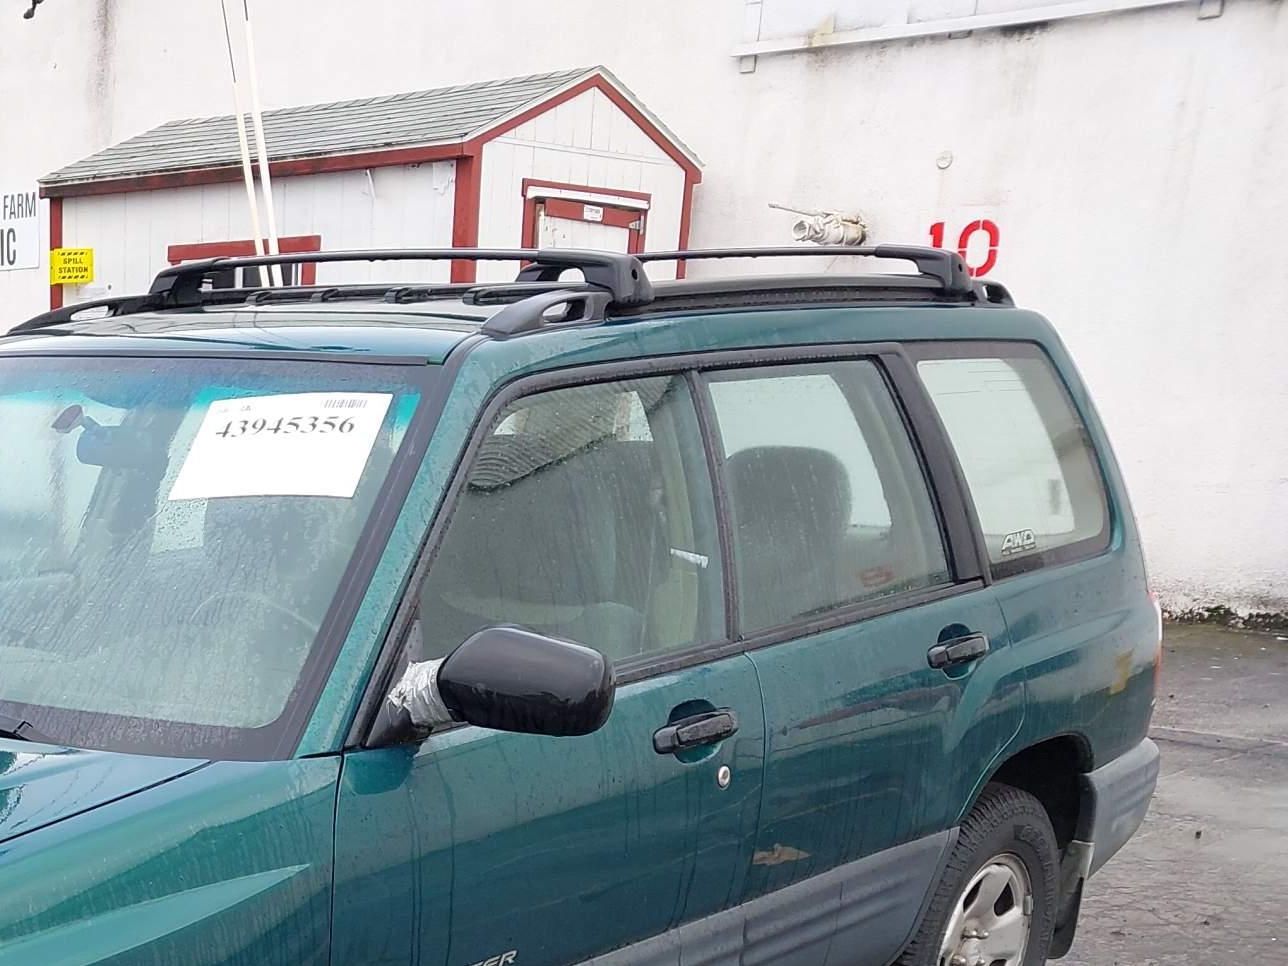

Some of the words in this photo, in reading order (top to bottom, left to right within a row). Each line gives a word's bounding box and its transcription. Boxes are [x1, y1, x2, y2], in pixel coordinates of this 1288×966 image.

[3, 192, 37, 220] FARM
[58, 266, 89, 274] STATION
[63, 257, 84, 265] SPILL
[216, 416, 356, 438] 43945356
[1002, 529, 1035, 550] AWD
